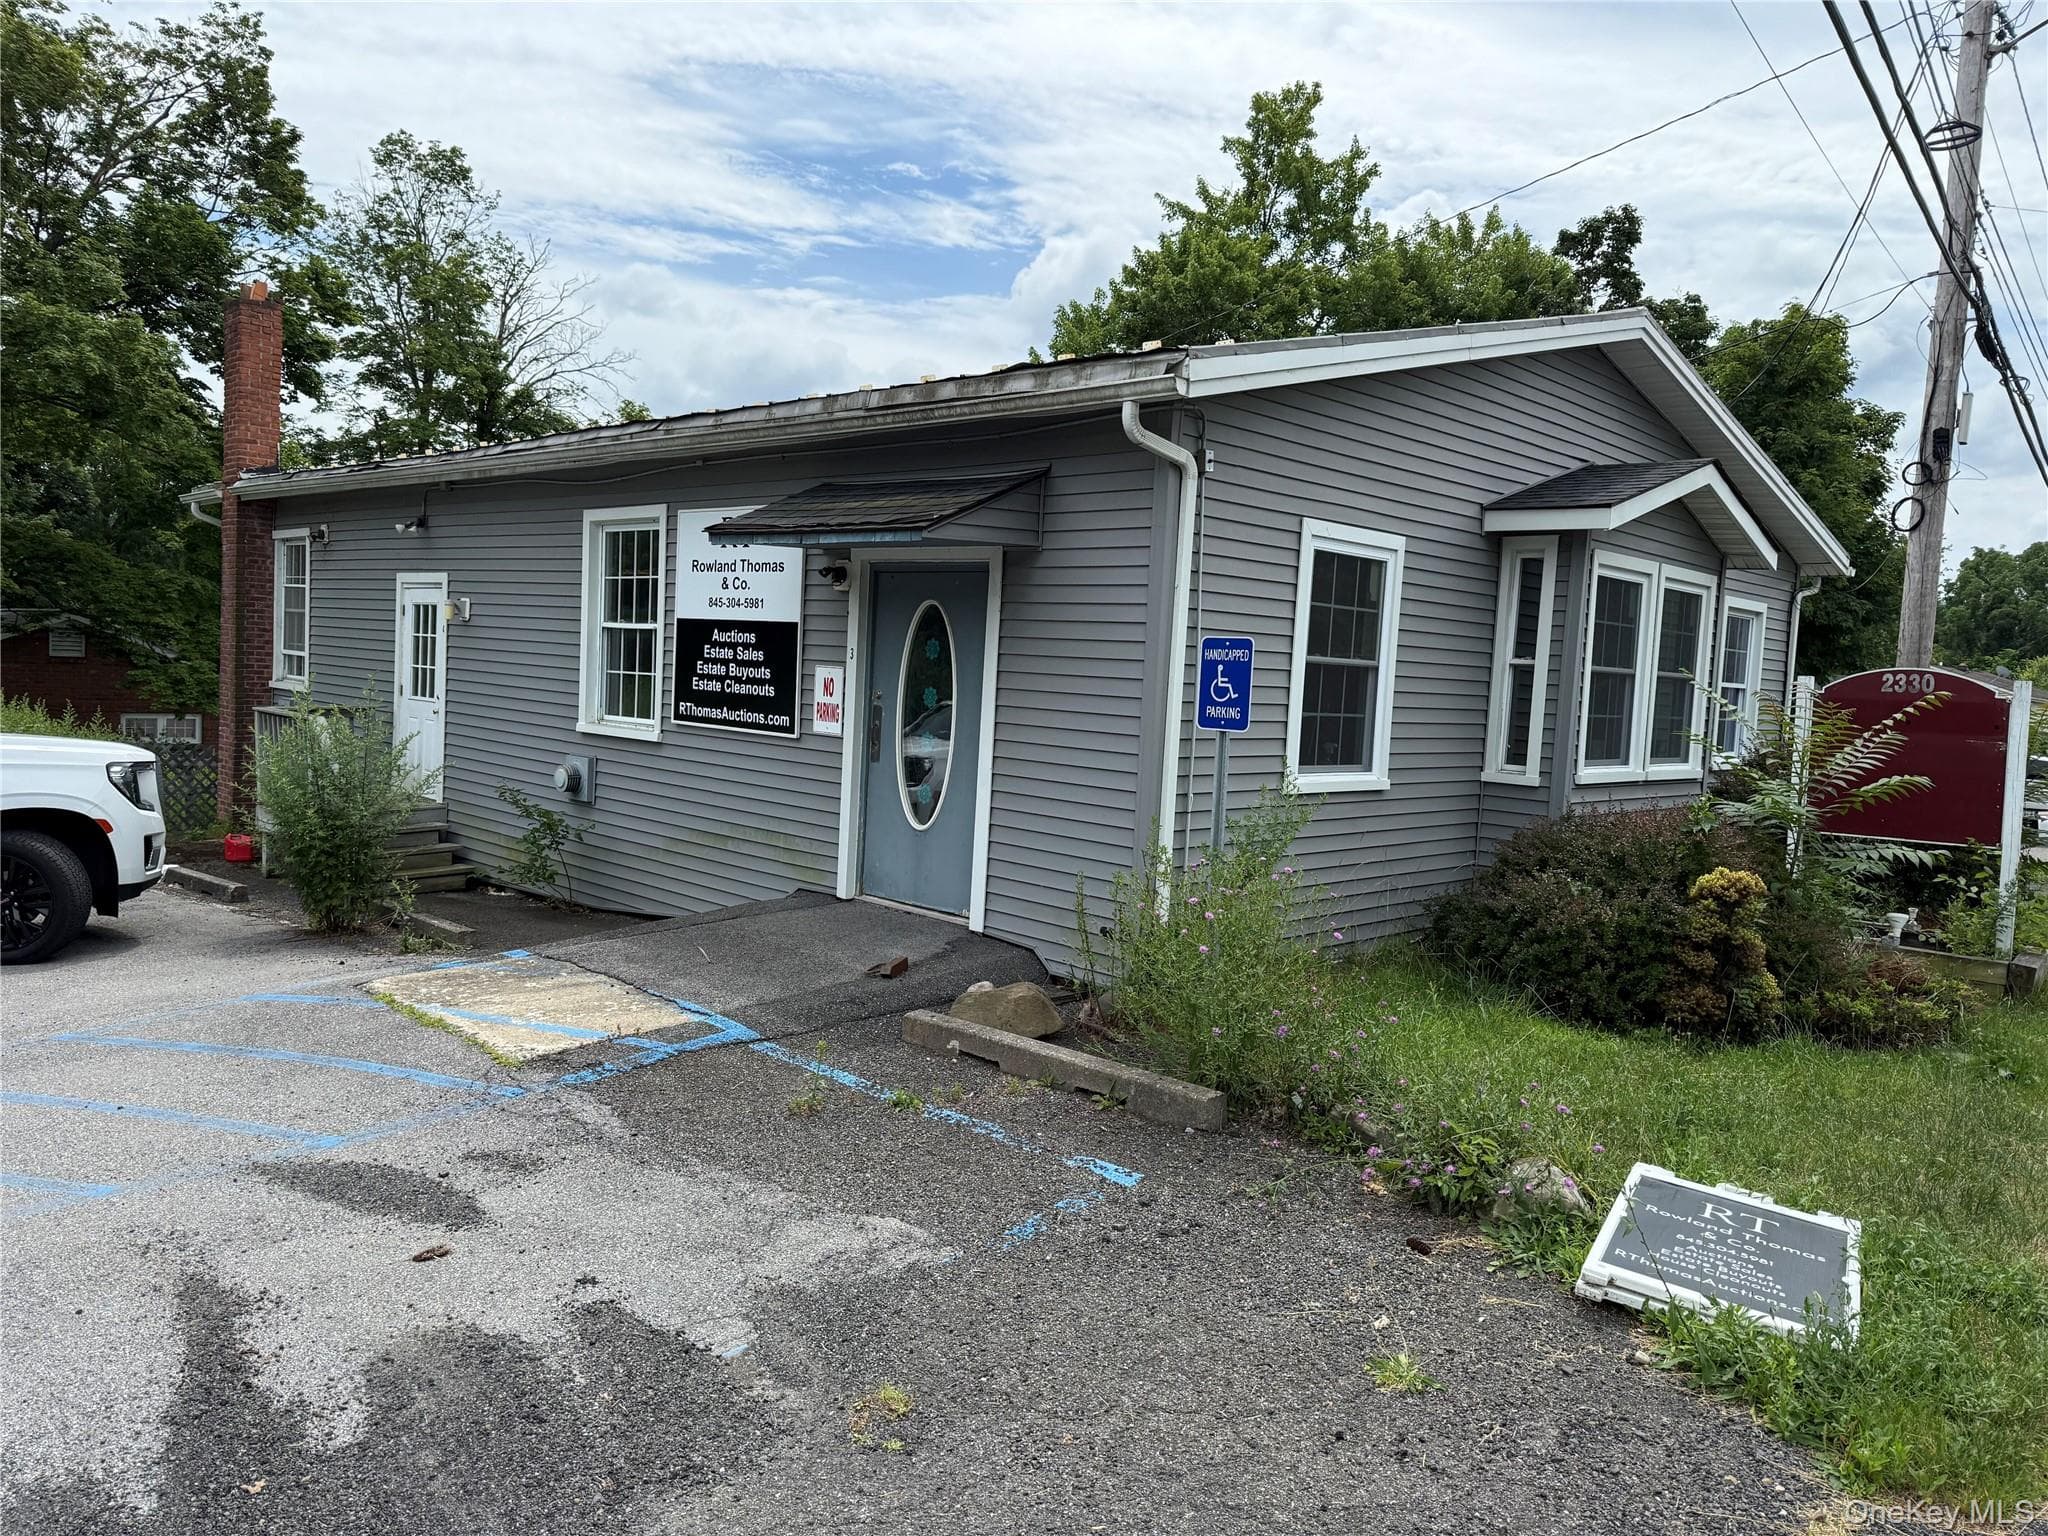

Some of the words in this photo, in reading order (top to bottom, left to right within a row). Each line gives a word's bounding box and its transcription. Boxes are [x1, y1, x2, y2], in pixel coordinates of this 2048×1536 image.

[692, 559, 737, 573] Rowland
[740, 559, 785, 573] Thomas
[721, 577, 729, 590] &
[732, 577, 751, 590] Co.
[708, 597, 764, 609] 845-304-5981
[712, 628, 756, 644] Auctions
[704, 645, 734, 659] Estate
[736, 646, 764, 661] Sales
[1204, 648, 1250, 662] HANDICAPPED
[697, 661, 726, 675] Estate
[729, 663, 771, 680] Buyouts
[692, 676, 721, 692] Estate
[724, 680, 775, 697] Cleanouts
[823, 677, 835, 698] NO
[1881, 673, 1936, 693] 2330
[679, 702, 790, 727] RThomasAuctions.com
[816, 701, 840, 724] PARKING
[1206, 705, 1241, 720] PARKING
[1697, 1201, 1780, 1235] RT
[1645, 1204, 1733, 1235] Rowland
[1742, 1232, 1826, 1263] Thomas
[1727, 1238, 1760, 1253] Co.
[1674, 1246, 1724, 1265] Estate
[1731, 1263, 1773, 1280] Sales
[1686, 1245, 1754, 1268] Auctions
[1661, 1248, 1711, 1268] Estate
[1718, 1265, 1782, 1289] Buyouts
[1703, 1268, 1786, 1297] Cleanouts
